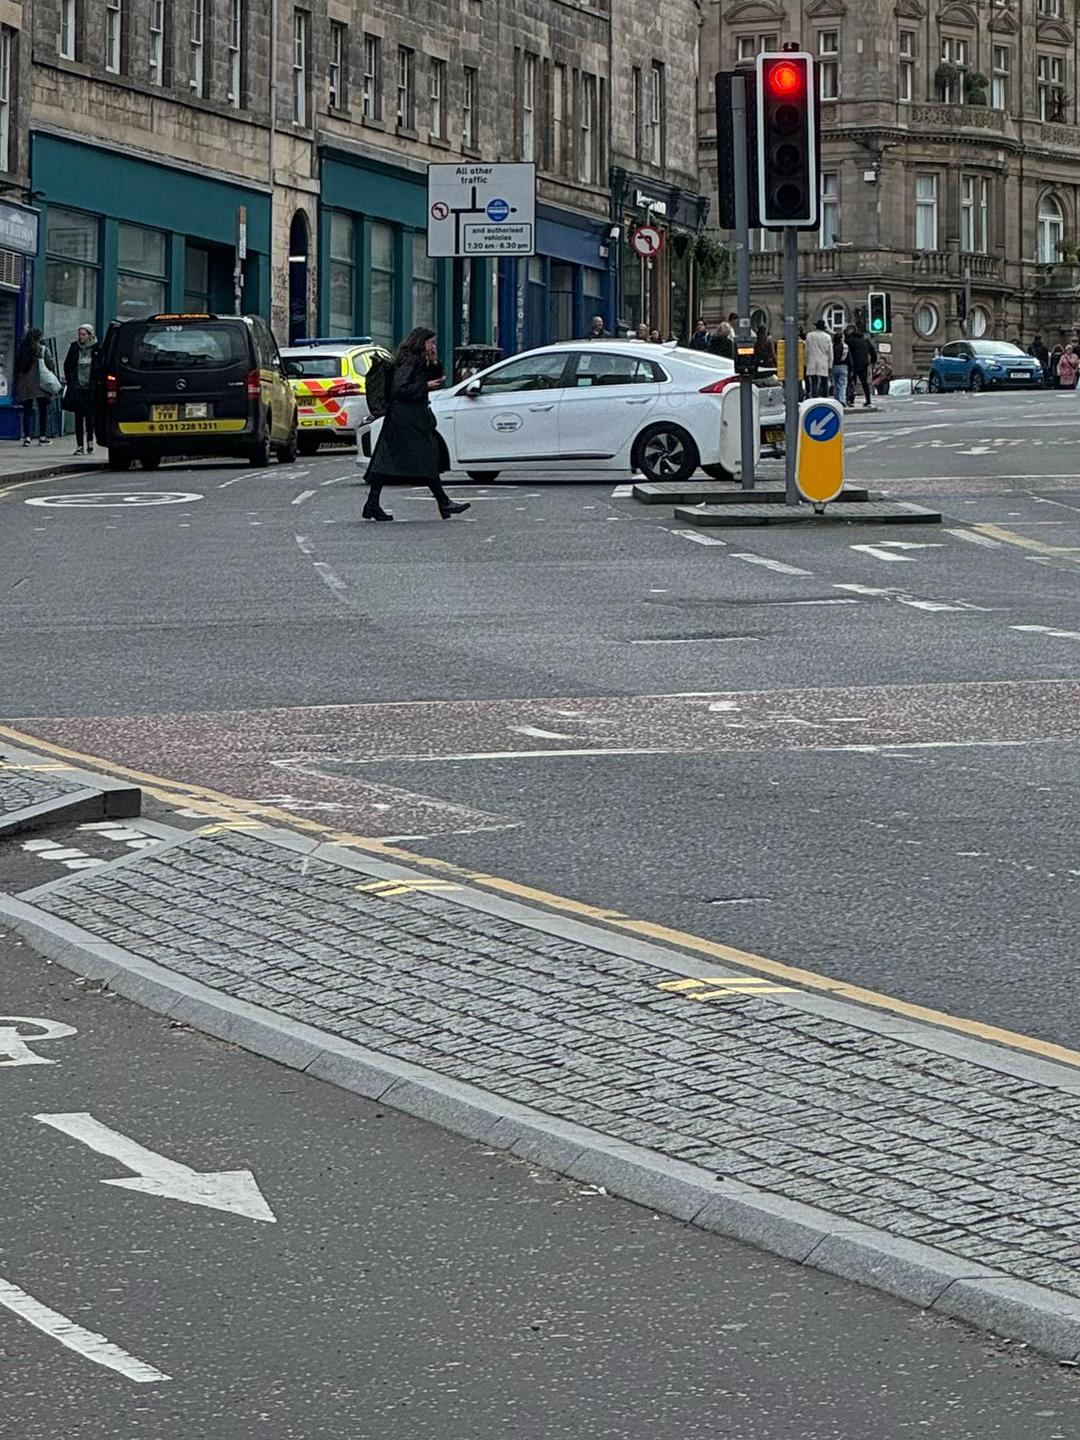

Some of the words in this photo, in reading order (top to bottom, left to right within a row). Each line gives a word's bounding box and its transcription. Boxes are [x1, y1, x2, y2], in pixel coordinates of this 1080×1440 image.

[456, 167, 468, 175] All
[470, 167, 493, 175] other
[461, 176, 488, 184] traffic
[159, 422, 179, 431] 0131
[180, 422, 196, 431] 228
[199, 422, 218, 430] 1211
